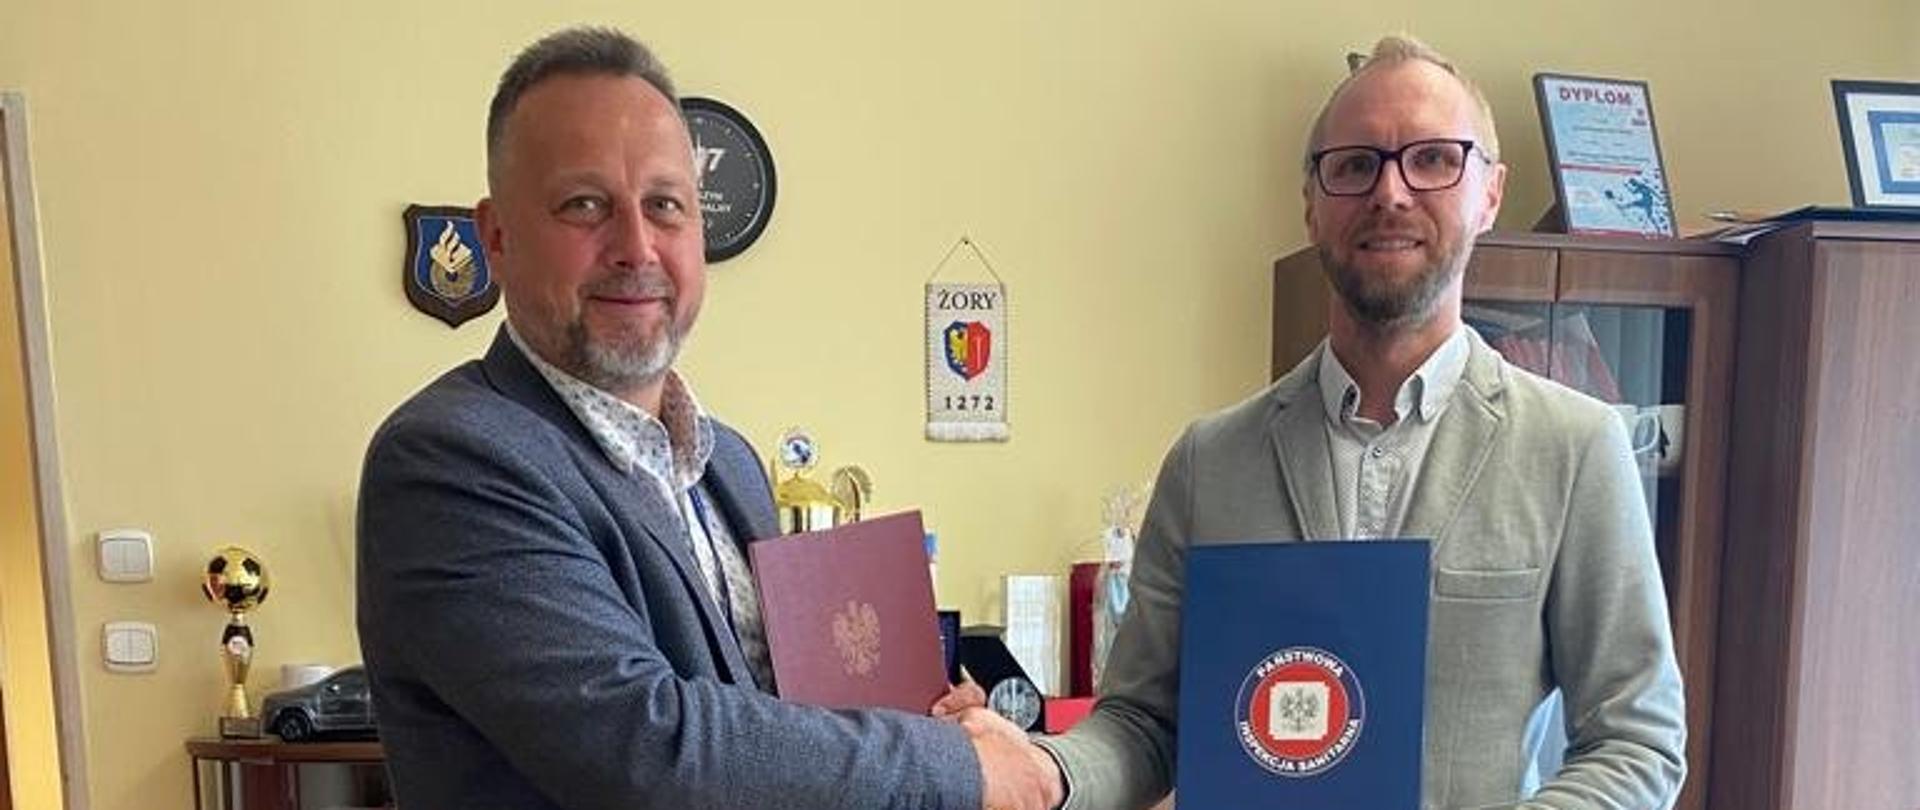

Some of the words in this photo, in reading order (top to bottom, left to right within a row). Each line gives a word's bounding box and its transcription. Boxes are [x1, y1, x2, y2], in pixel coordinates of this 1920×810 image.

[1559, 87, 1633, 105] DYPLOM
[937, 288, 997, 310] ŻORY
[944, 396, 994, 411] 1272
[1239, 720, 1296, 772] INSPEKCJA
[1297, 718, 1361, 772] SANITARNA
